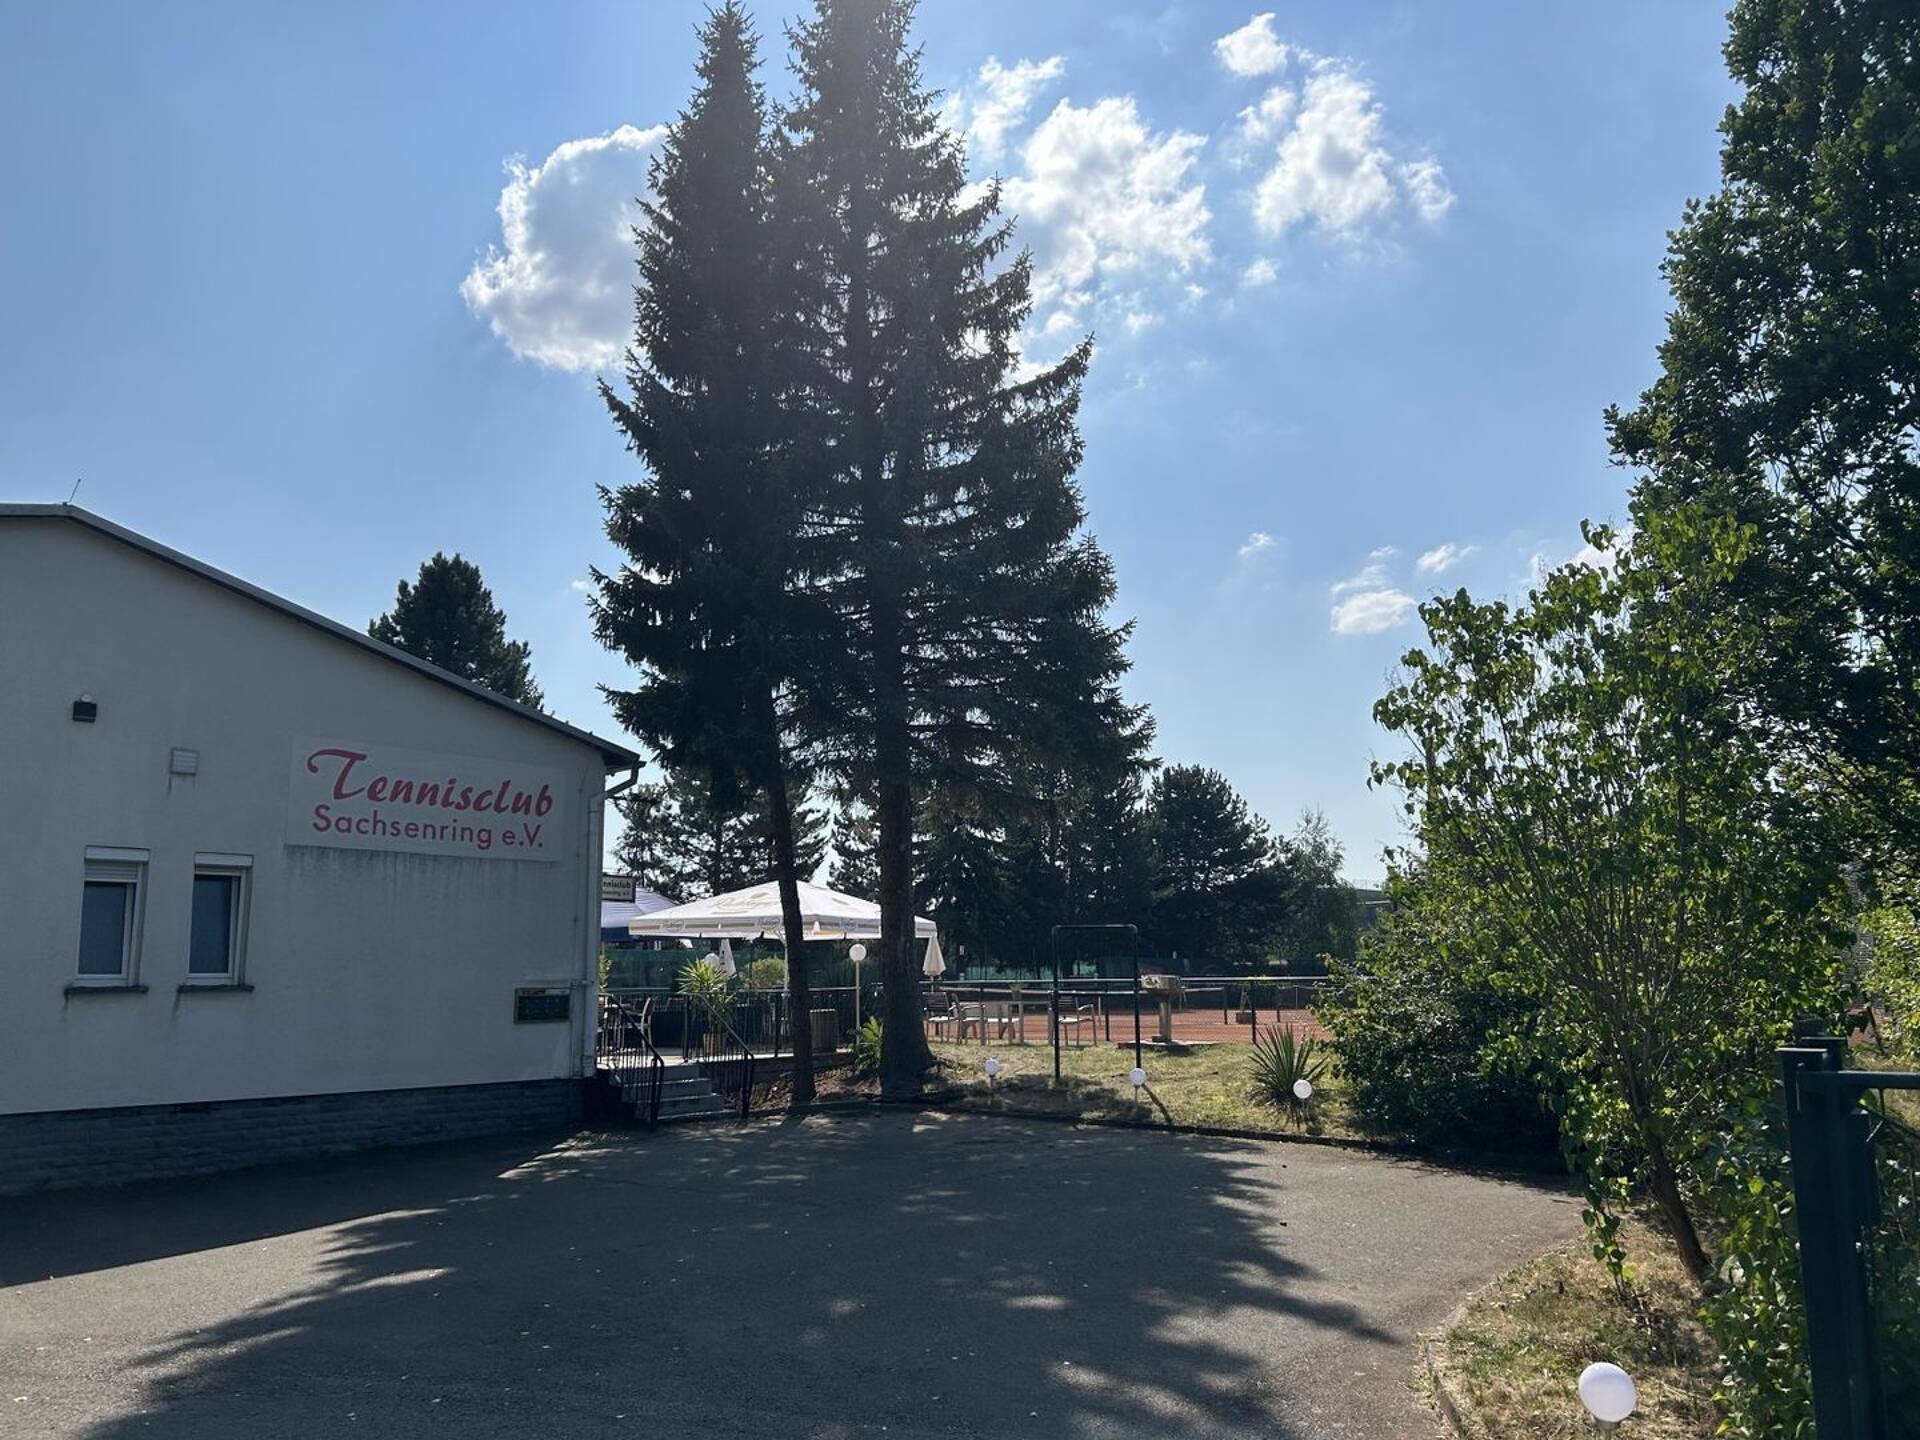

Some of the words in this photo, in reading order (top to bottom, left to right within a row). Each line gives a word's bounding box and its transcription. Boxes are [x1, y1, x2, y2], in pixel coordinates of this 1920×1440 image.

[307, 748, 553, 816] Tennisclub
[312, 804, 492, 850] Sachsenring
[502, 823, 543, 848] e.V.
